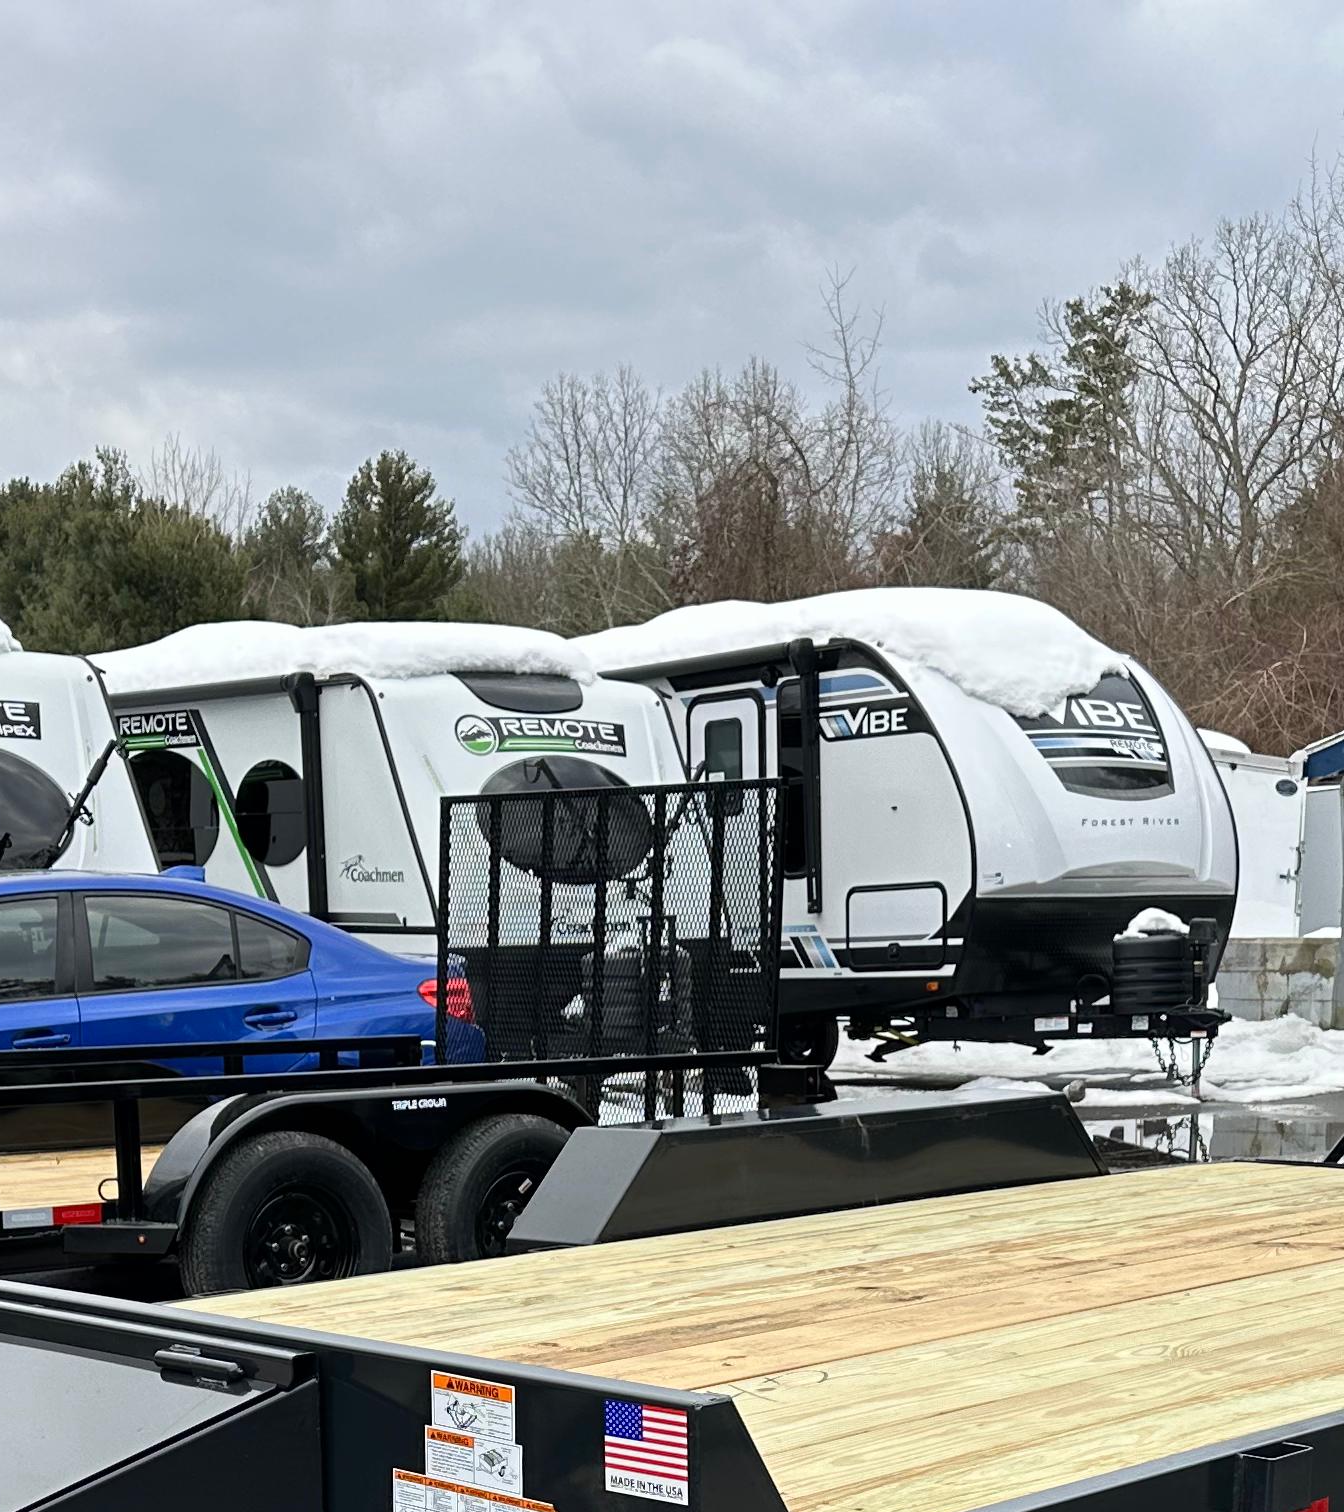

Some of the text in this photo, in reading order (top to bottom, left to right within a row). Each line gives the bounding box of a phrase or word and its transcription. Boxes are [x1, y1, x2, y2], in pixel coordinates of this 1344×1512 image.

[119, 711, 188, 736] REMOTE
[498, 719, 619, 741] REMOTE
[821, 707, 908, 736] VIBE
[1081, 817, 1180, 827] FOREST RIVER
[350, 866, 405, 882] Coachmen
[454, 1380, 499, 1398] WARNING
[610, 1475, 635, 1488] MADE
[636, 1479, 646, 1491] IN
[647, 1481, 664, 1494] THE
[665, 1485, 683, 1498] USA
